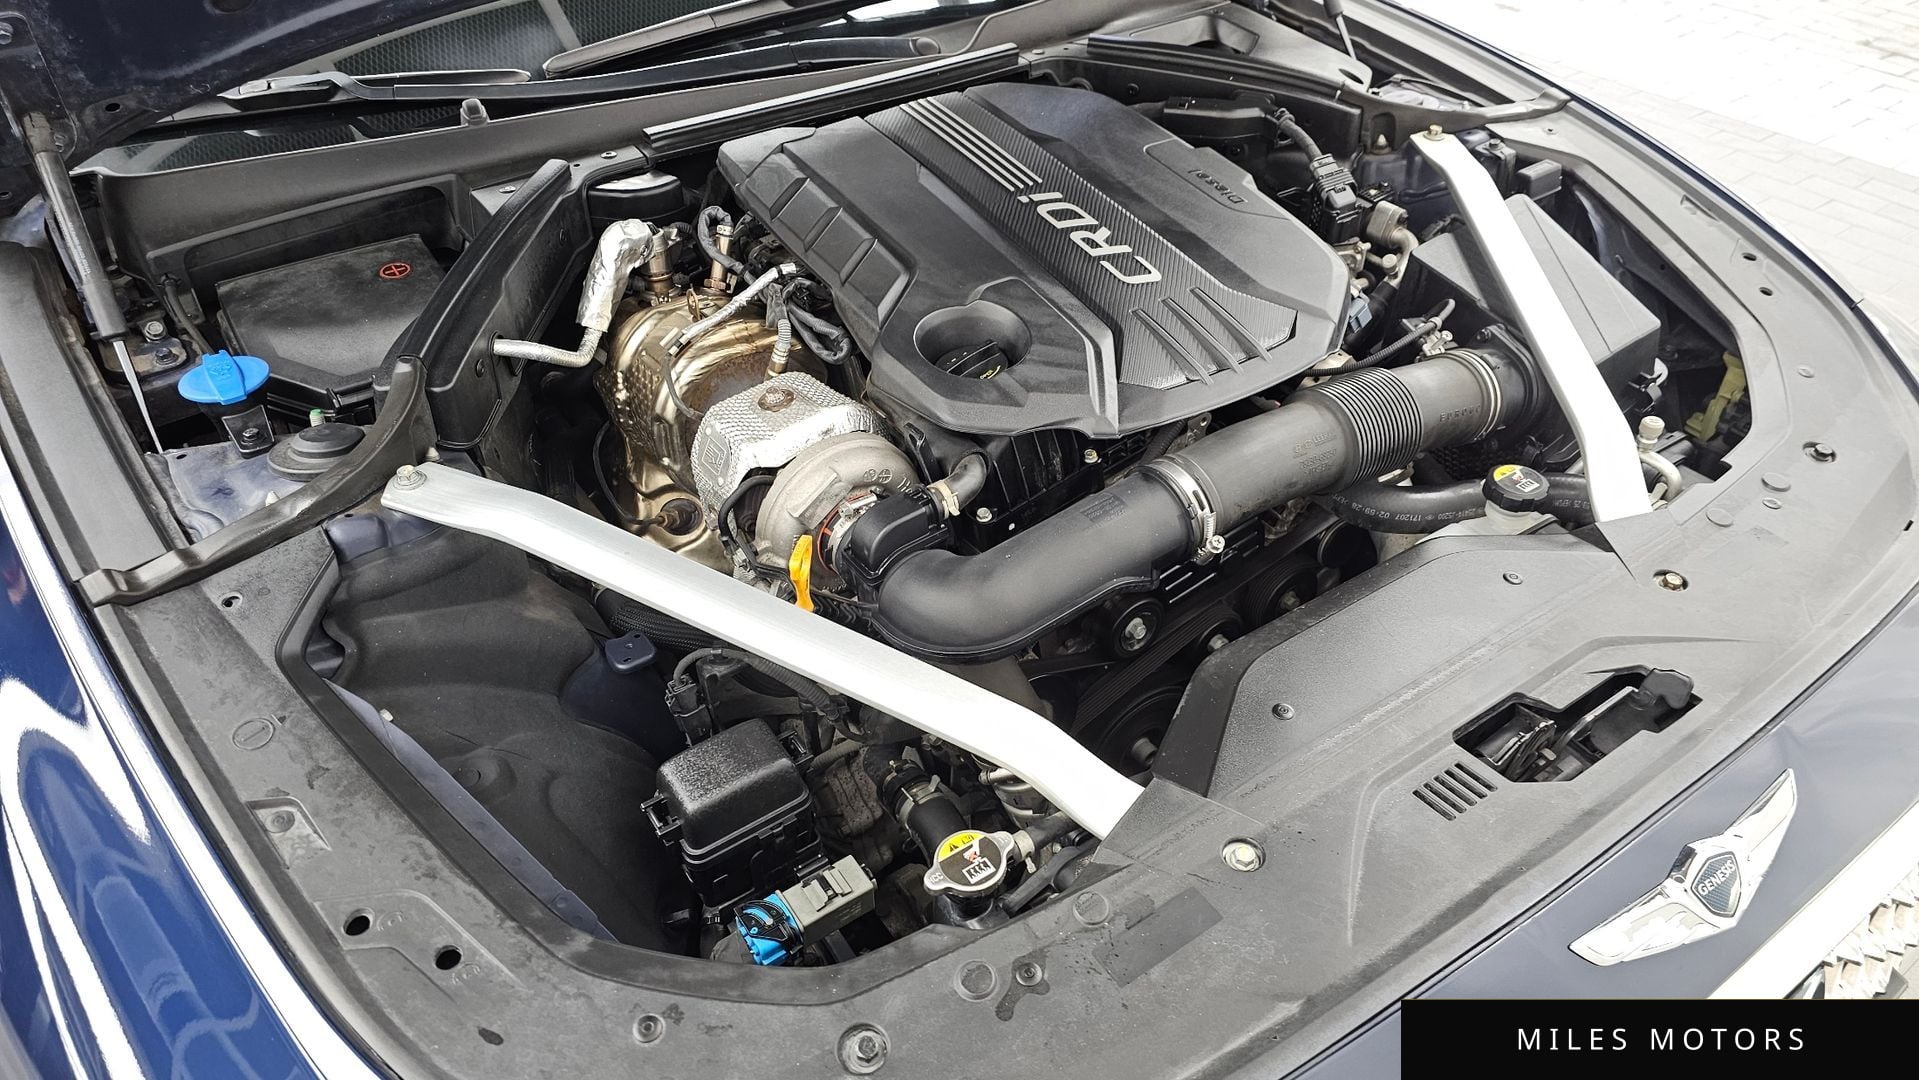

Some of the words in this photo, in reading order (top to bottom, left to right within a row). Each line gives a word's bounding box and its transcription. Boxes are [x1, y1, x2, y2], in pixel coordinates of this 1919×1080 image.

[1187, 169, 1247, 204] Diesel
[1017, 191, 1162, 285] CRDi
[1697, 859, 1736, 896] GENESIS
